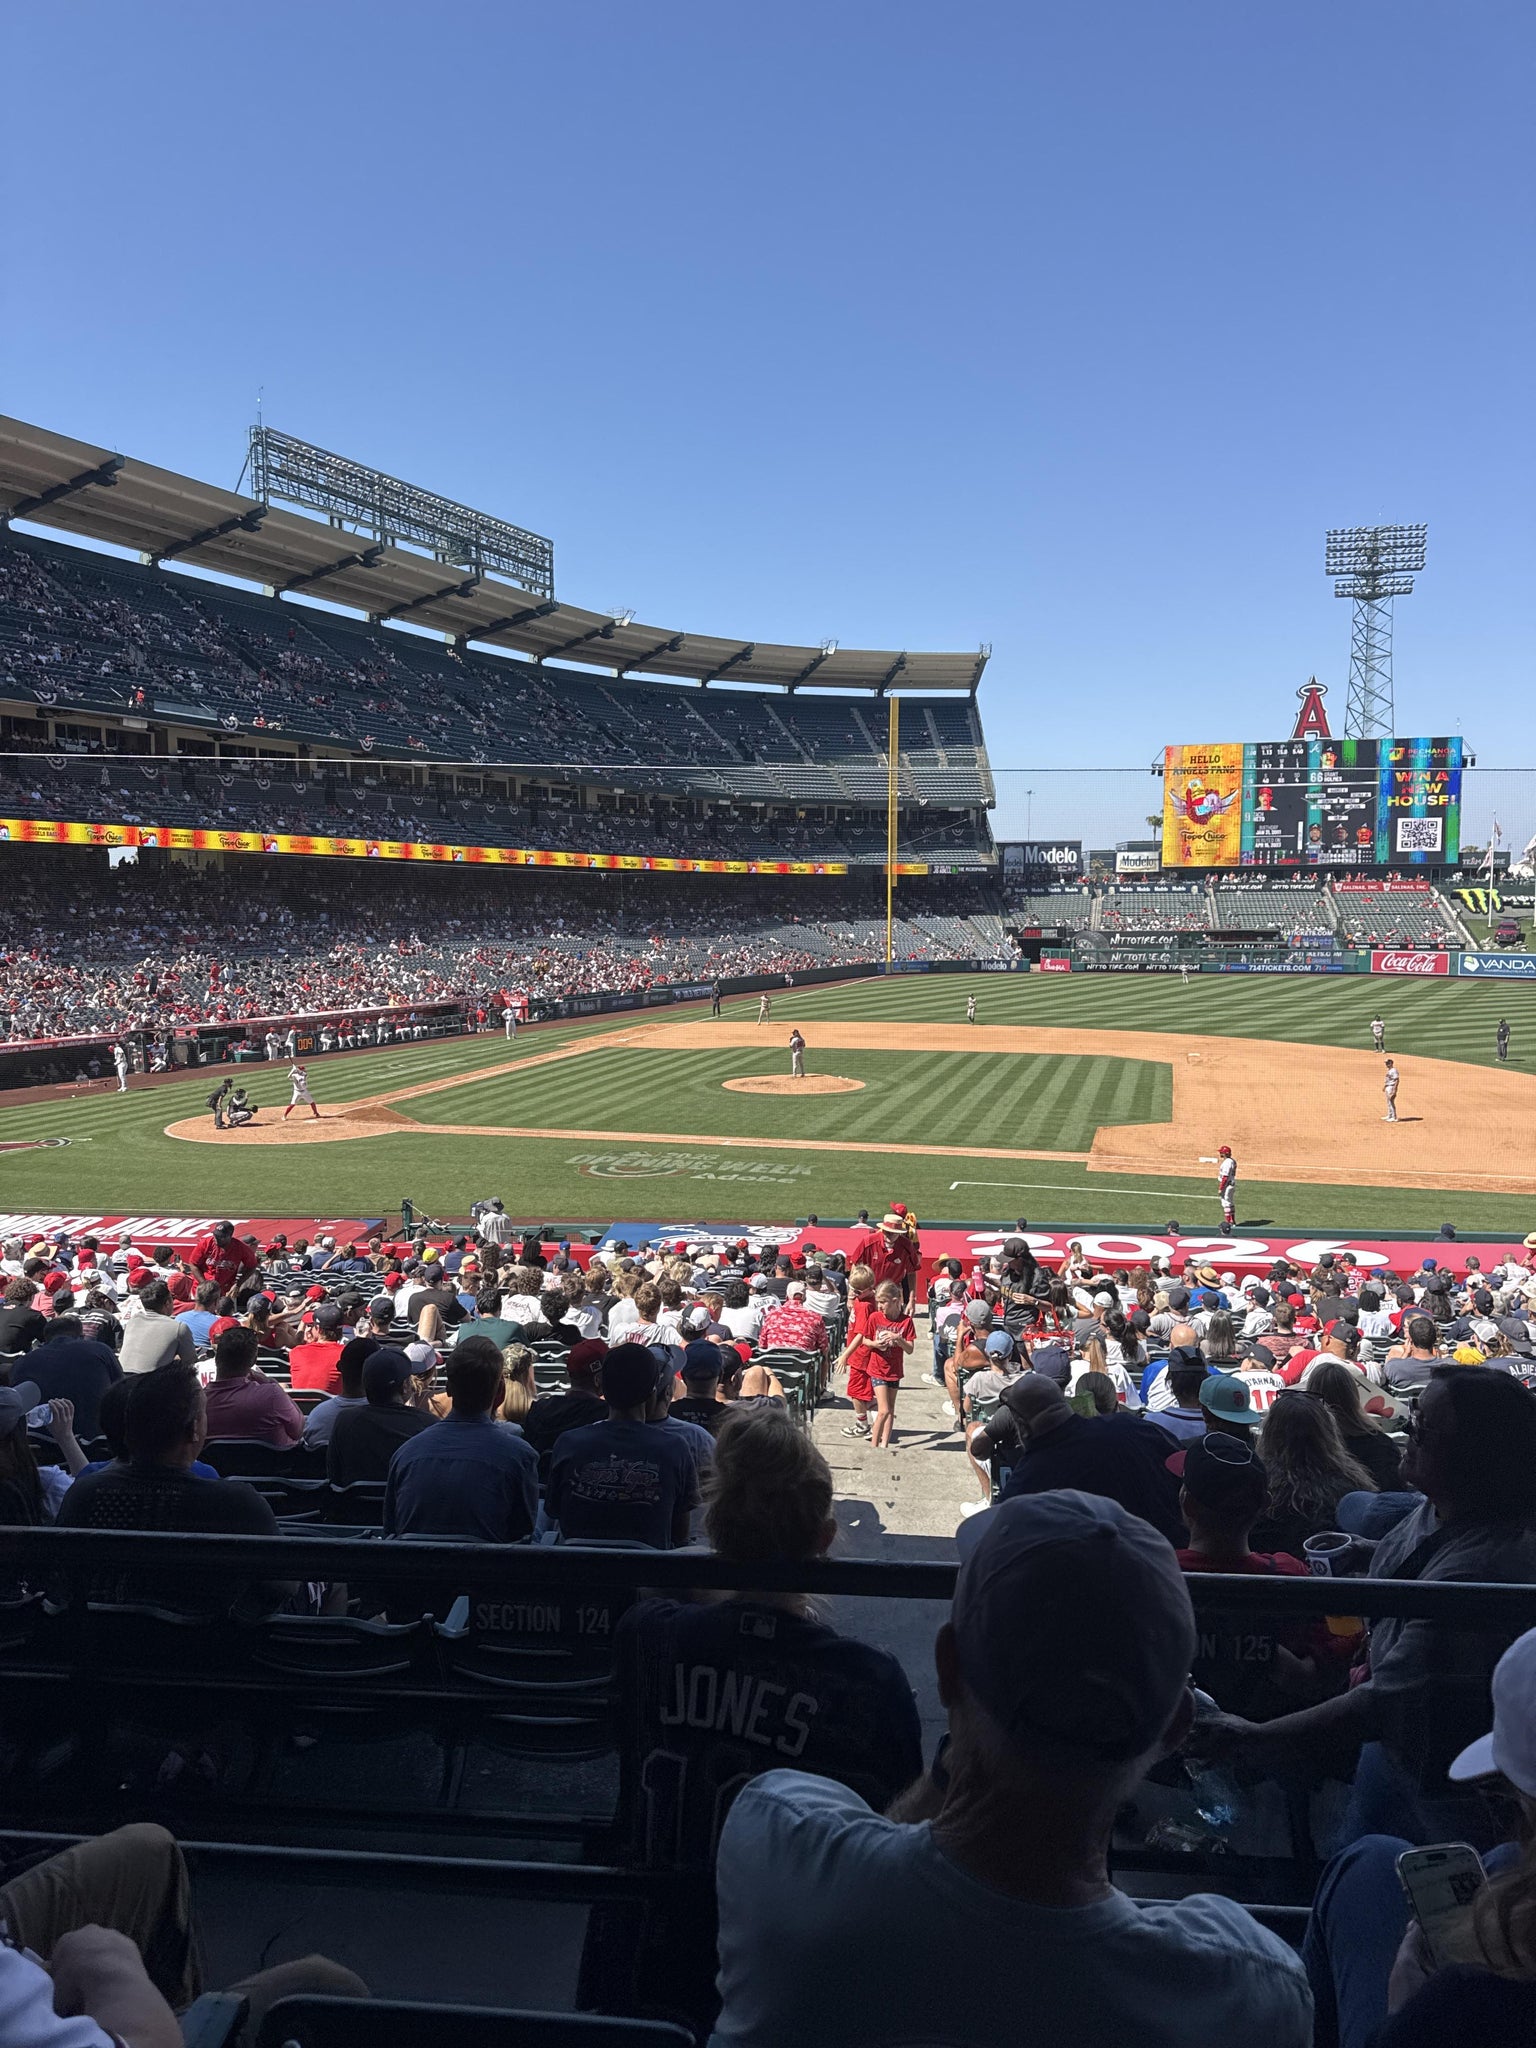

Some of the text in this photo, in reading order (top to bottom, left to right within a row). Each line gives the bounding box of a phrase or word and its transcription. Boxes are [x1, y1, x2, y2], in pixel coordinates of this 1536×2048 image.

[1190, 755, 1220, 764] HELLO
[1173, 765, 1235, 775] ANGELS FANS
[1310, 772, 1323, 782] 66
[1395, 771, 1449, 782] WIN A
[1402, 783, 1442, 794] NEW
[1387, 795, 1456, 806] HOUSE!
[1181, 830, 1225, 842] Topo Chico
[1025, 846, 1077, 863] Modelo
[1122, 855, 1154, 866] Modelo
[981, 961, 1007, 970] Modelo
[1380, 953, 1438, 972] Coca-Cola
[1480, 959, 1536, 970] VANDA
[564, 1154, 818, 1175] OPENING WEEK
[690, 1172, 797, 1184] Adobe
[966, 1232, 1390, 1266] 2026
[476, 1602, 610, 1635] SECTION 124
[1233, 1635, 1270, 1661] 125
[660, 1663, 818, 1758] JONES
